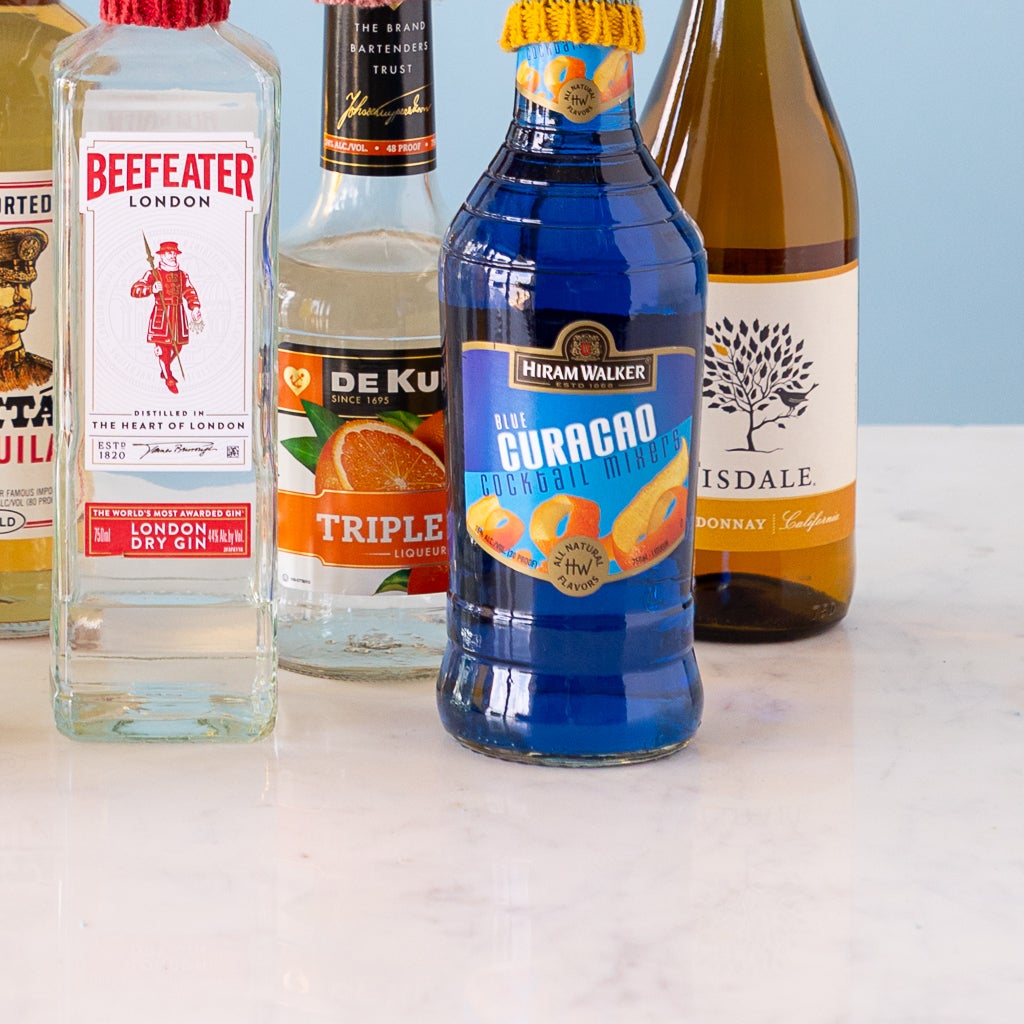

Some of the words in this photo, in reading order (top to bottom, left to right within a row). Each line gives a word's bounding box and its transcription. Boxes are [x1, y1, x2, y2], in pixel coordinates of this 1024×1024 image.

[355, 23, 378, 33] THE
[387, 21, 426, 33] BRAND
[350, 41, 428, 54] BARTENDERS
[373, 64, 413, 75] TRUST
[564, 90, 572, 101] ALL
[571, 84, 595, 100] NATURAL
[571, 95, 588, 106] HW
[386, 144, 396, 152] 48
[398, 143, 421, 152] PROOF
[87, 153, 254, 202] BEEFEATER
[129, 195, 210, 208] LONDON
[523, 360, 578, 381] HIRAM
[581, 364, 646, 381] WALKER
[331, 371, 379, 393] DE
[331, 395, 361, 404] SINCE
[367, 397, 389, 405] 1695
[92, 421, 116, 430] THE
[122, 421, 163, 430] HEART
[168, 421, 185, 430] OF
[190, 421, 245, 430] LONDON
[495, 412, 527, 429] BLUE
[497, 403, 656, 472] CURACAO
[99, 451, 126, 460] 1820
[700, 465, 812, 490] ISDALE
[6, 488, 34, 497] FAMOUS
[93, 509, 110, 517] THE
[112, 509, 151, 517] WORLD'S
[154, 509, 177, 517] MOST
[180, 509, 223, 517] AWARDED
[779, 510, 840, 532] California
[94, 527, 111, 543] 750ml
[131, 522, 206, 535] LONDON
[316, 513, 443, 544] TRIPLE
[131, 537, 167, 550] DRY
[174, 537, 206, 550] GIN
[394, 546, 446, 558] LIQUEUR
[554, 551, 566, 568] ALL
[565, 542, 603, 567] NATURAL
[565, 558, 593, 576] HW
[557, 575, 599, 591] FLAVORS
